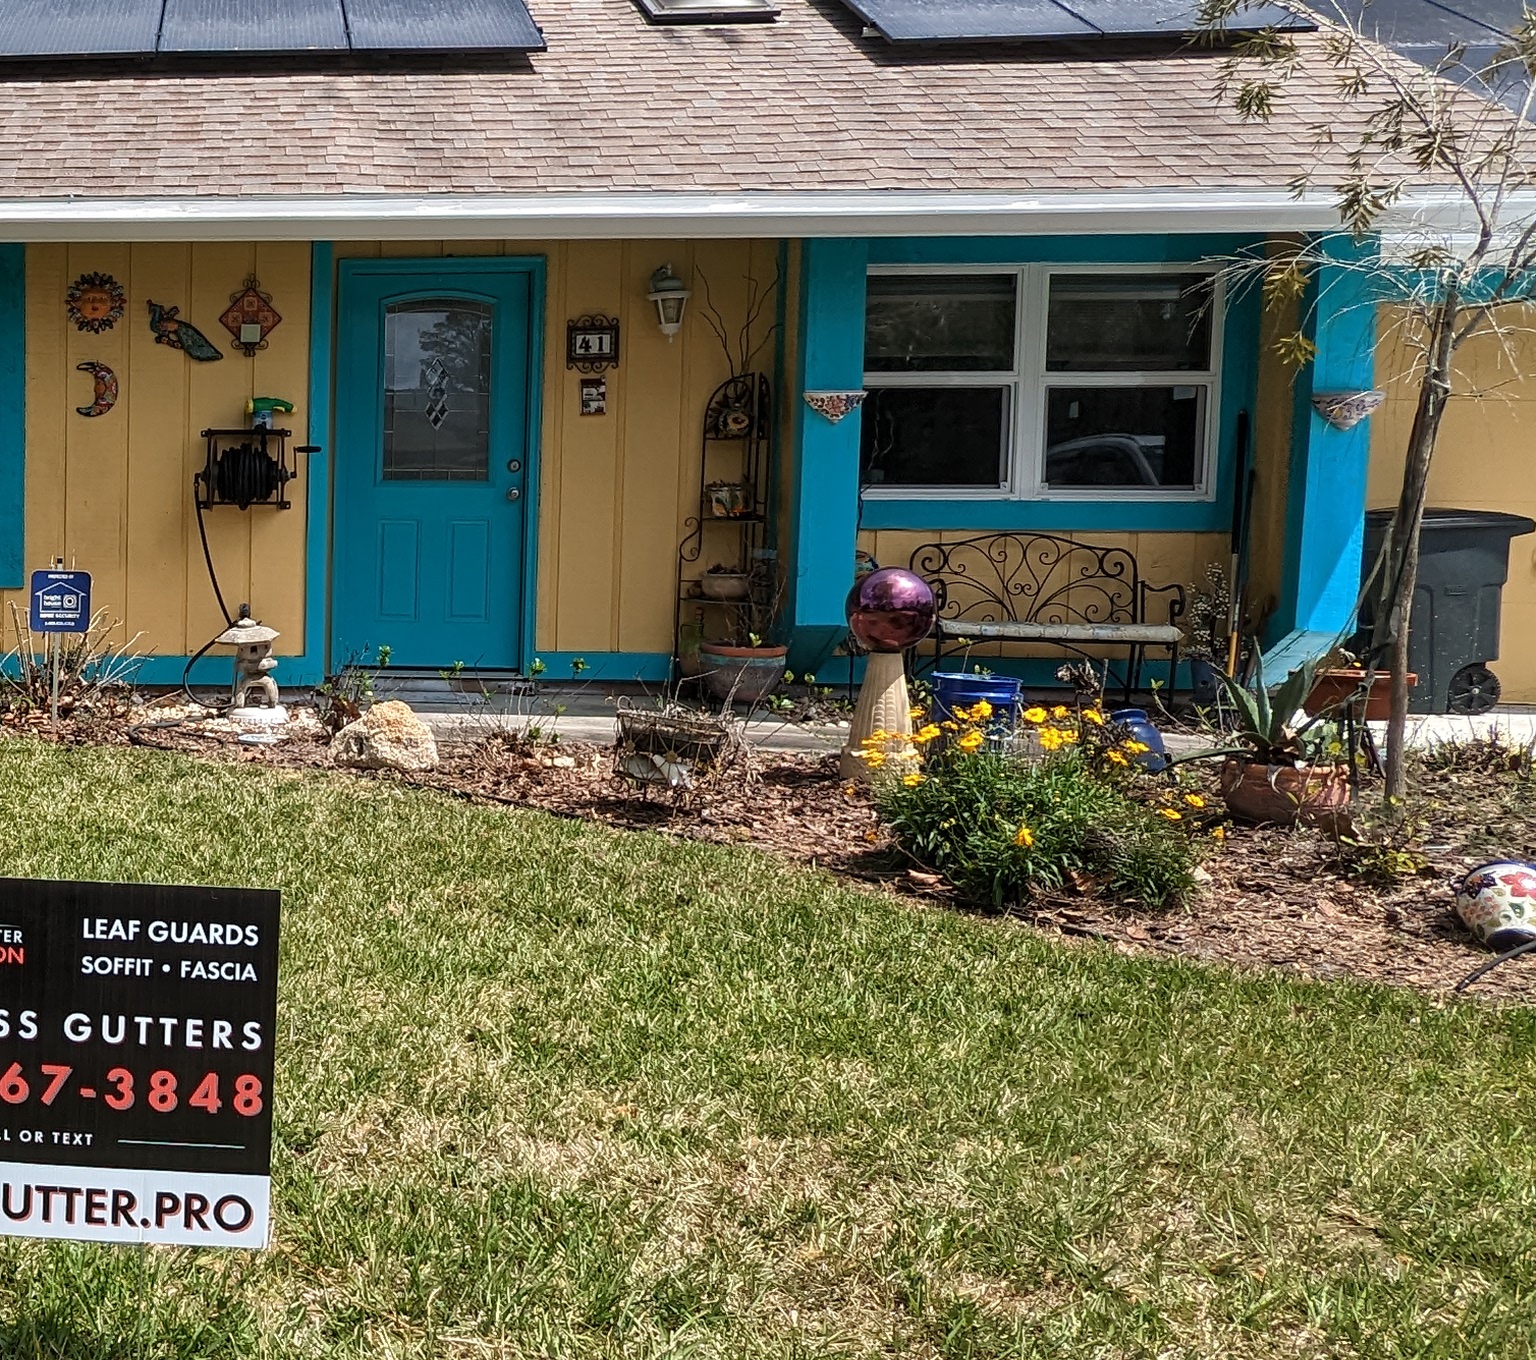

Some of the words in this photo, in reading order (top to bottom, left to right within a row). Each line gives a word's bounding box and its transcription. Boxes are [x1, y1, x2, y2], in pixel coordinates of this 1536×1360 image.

[579, 336, 604, 352] 41
[82, 918, 141, 941] LEAF
[147, 920, 259, 946] GUARDS
[81, 956, 153, 977] SOFFIT
[180, 960, 257, 982] FASCIA
[63, 1012, 262, 1050] GUTTERS
[19, 1129, 44, 1144] OR
[51, 1132, 93, 1146] TEXT
